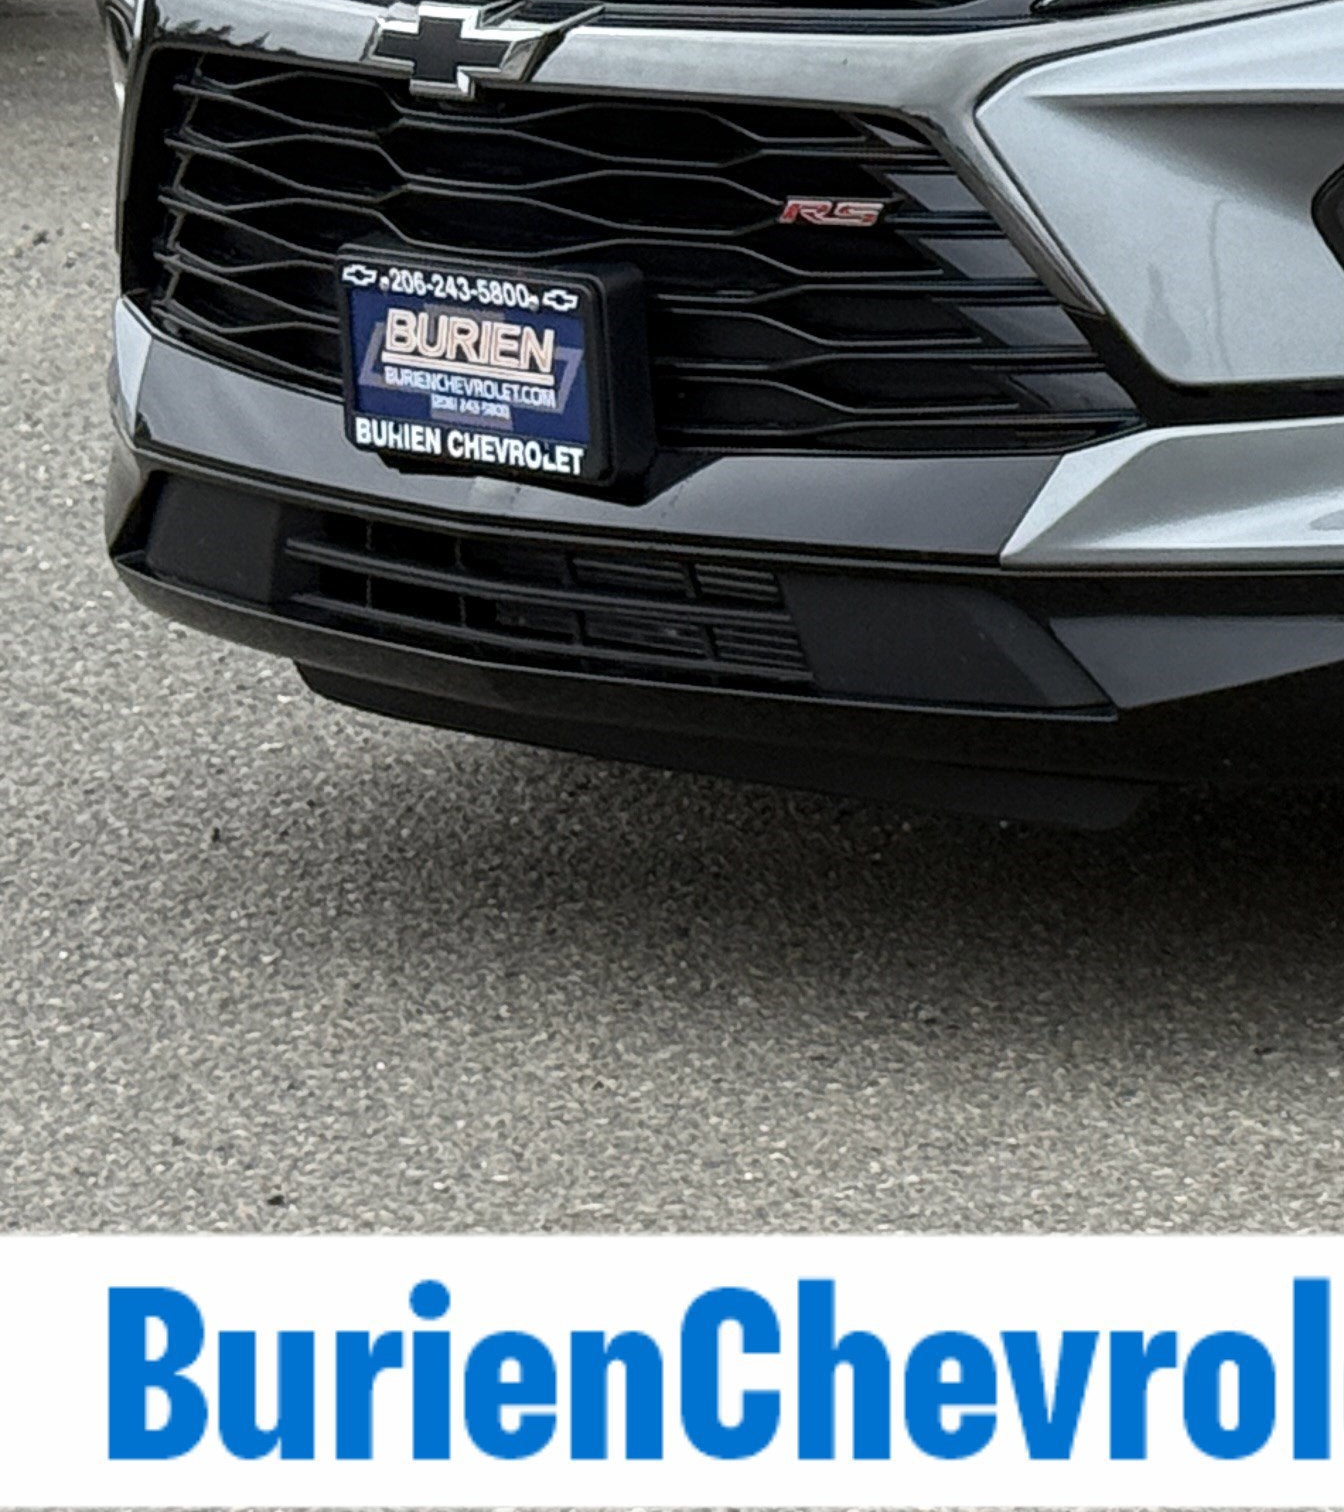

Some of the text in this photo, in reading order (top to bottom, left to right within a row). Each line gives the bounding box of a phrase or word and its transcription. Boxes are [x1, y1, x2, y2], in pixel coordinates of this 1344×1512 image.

[778, 199, 884, 226] RS
[388, 268, 530, 309] 206-243-5800
[385, 308, 555, 373] BURIEN
[383, 365, 557, 409] BURIENCHEVROLET.COM
[355, 417, 442, 455] BURIEN
